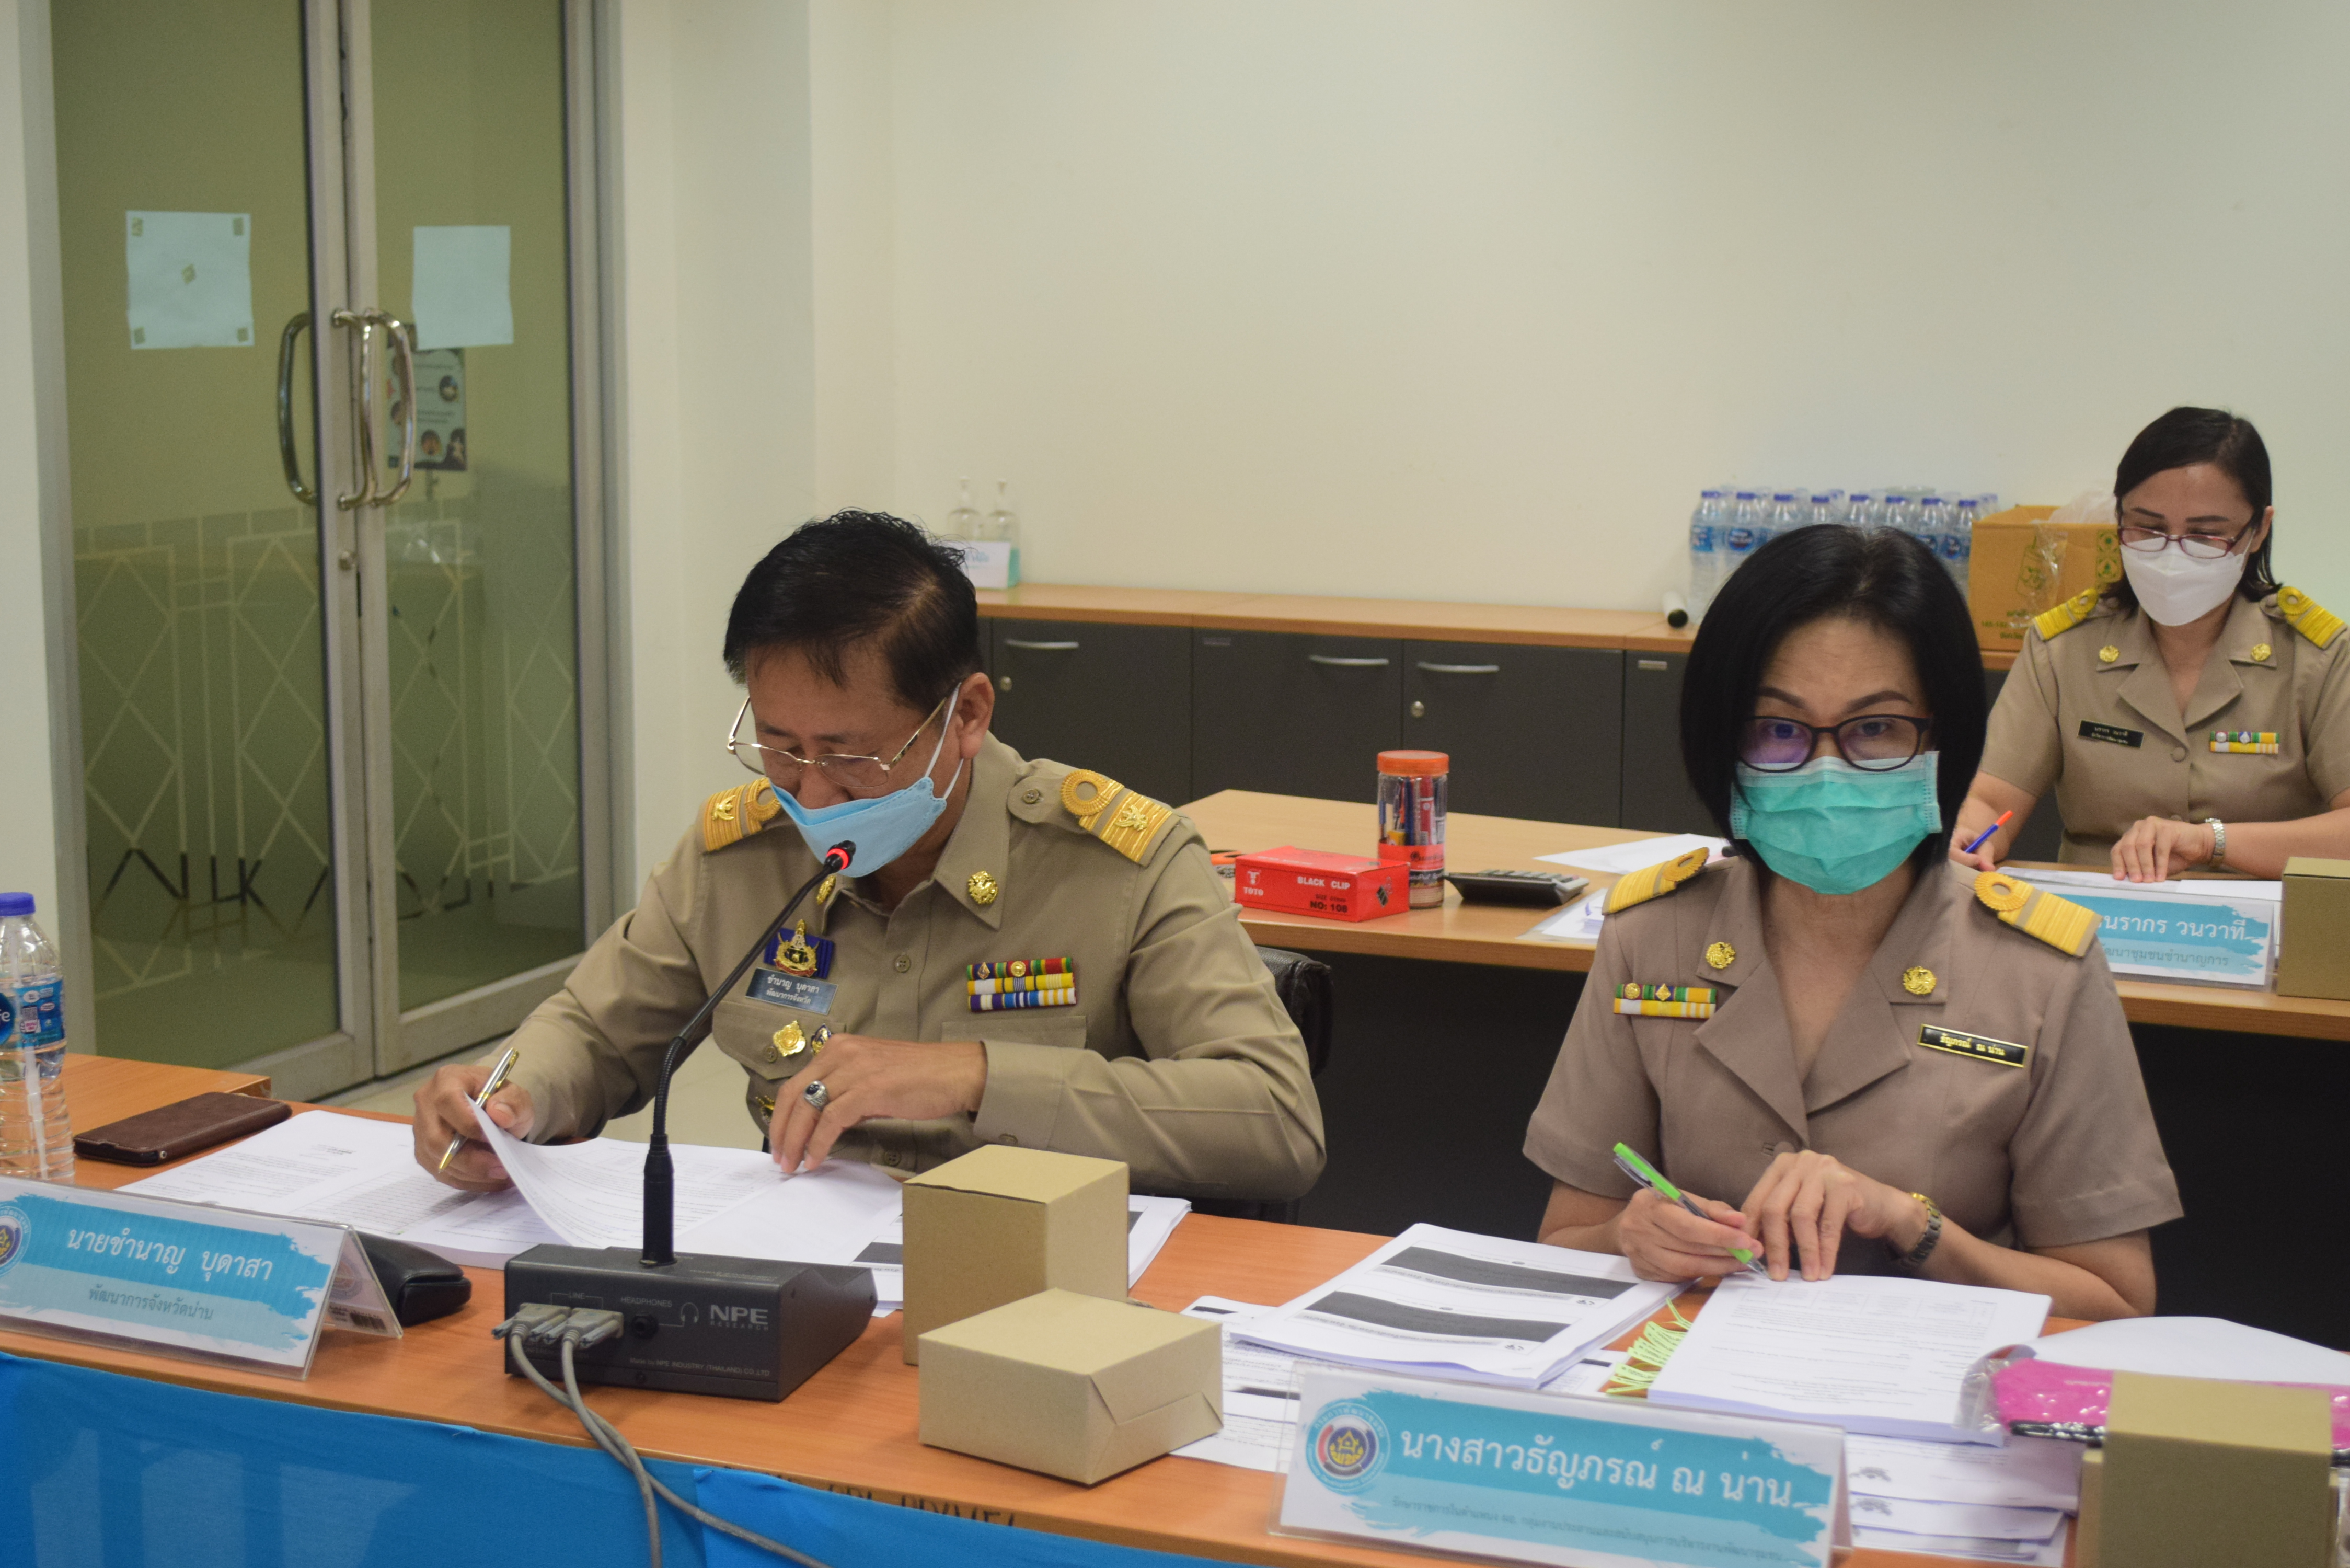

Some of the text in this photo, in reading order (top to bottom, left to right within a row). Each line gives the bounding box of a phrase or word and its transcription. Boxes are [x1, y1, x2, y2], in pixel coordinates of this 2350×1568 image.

[1297, 876, 1350, 890] BLACK CLIP
[1243, 886, 1264, 896] TOTO
[1310, 901, 1328, 910] NO:
[2099, 915, 2245, 940] นรากร วนวาที
[767, 974, 792, 990] ชำนาญ
[67, 1228, 186, 1274] นายชำนาญ
[202, 1251, 273, 1282] บุดาสา
[89, 1284, 214, 1320] พัฒนาการจังหวัดน่าน
[621, 1296, 672, 1307] HEADPHONES
[710, 1304, 769, 1325] NPE
[710, 1320, 769, 1331] RESEARCH
[672, 1361, 704, 1369] INDUSTRY
[706, 1364, 742, 1374] (THAILAND)
[1401, 1430, 1664, 1490] นางสาวธัญภรณ์
[1673, 1467, 1705, 1495] ณ
[1720, 1451, 1791, 1507] น่าน
